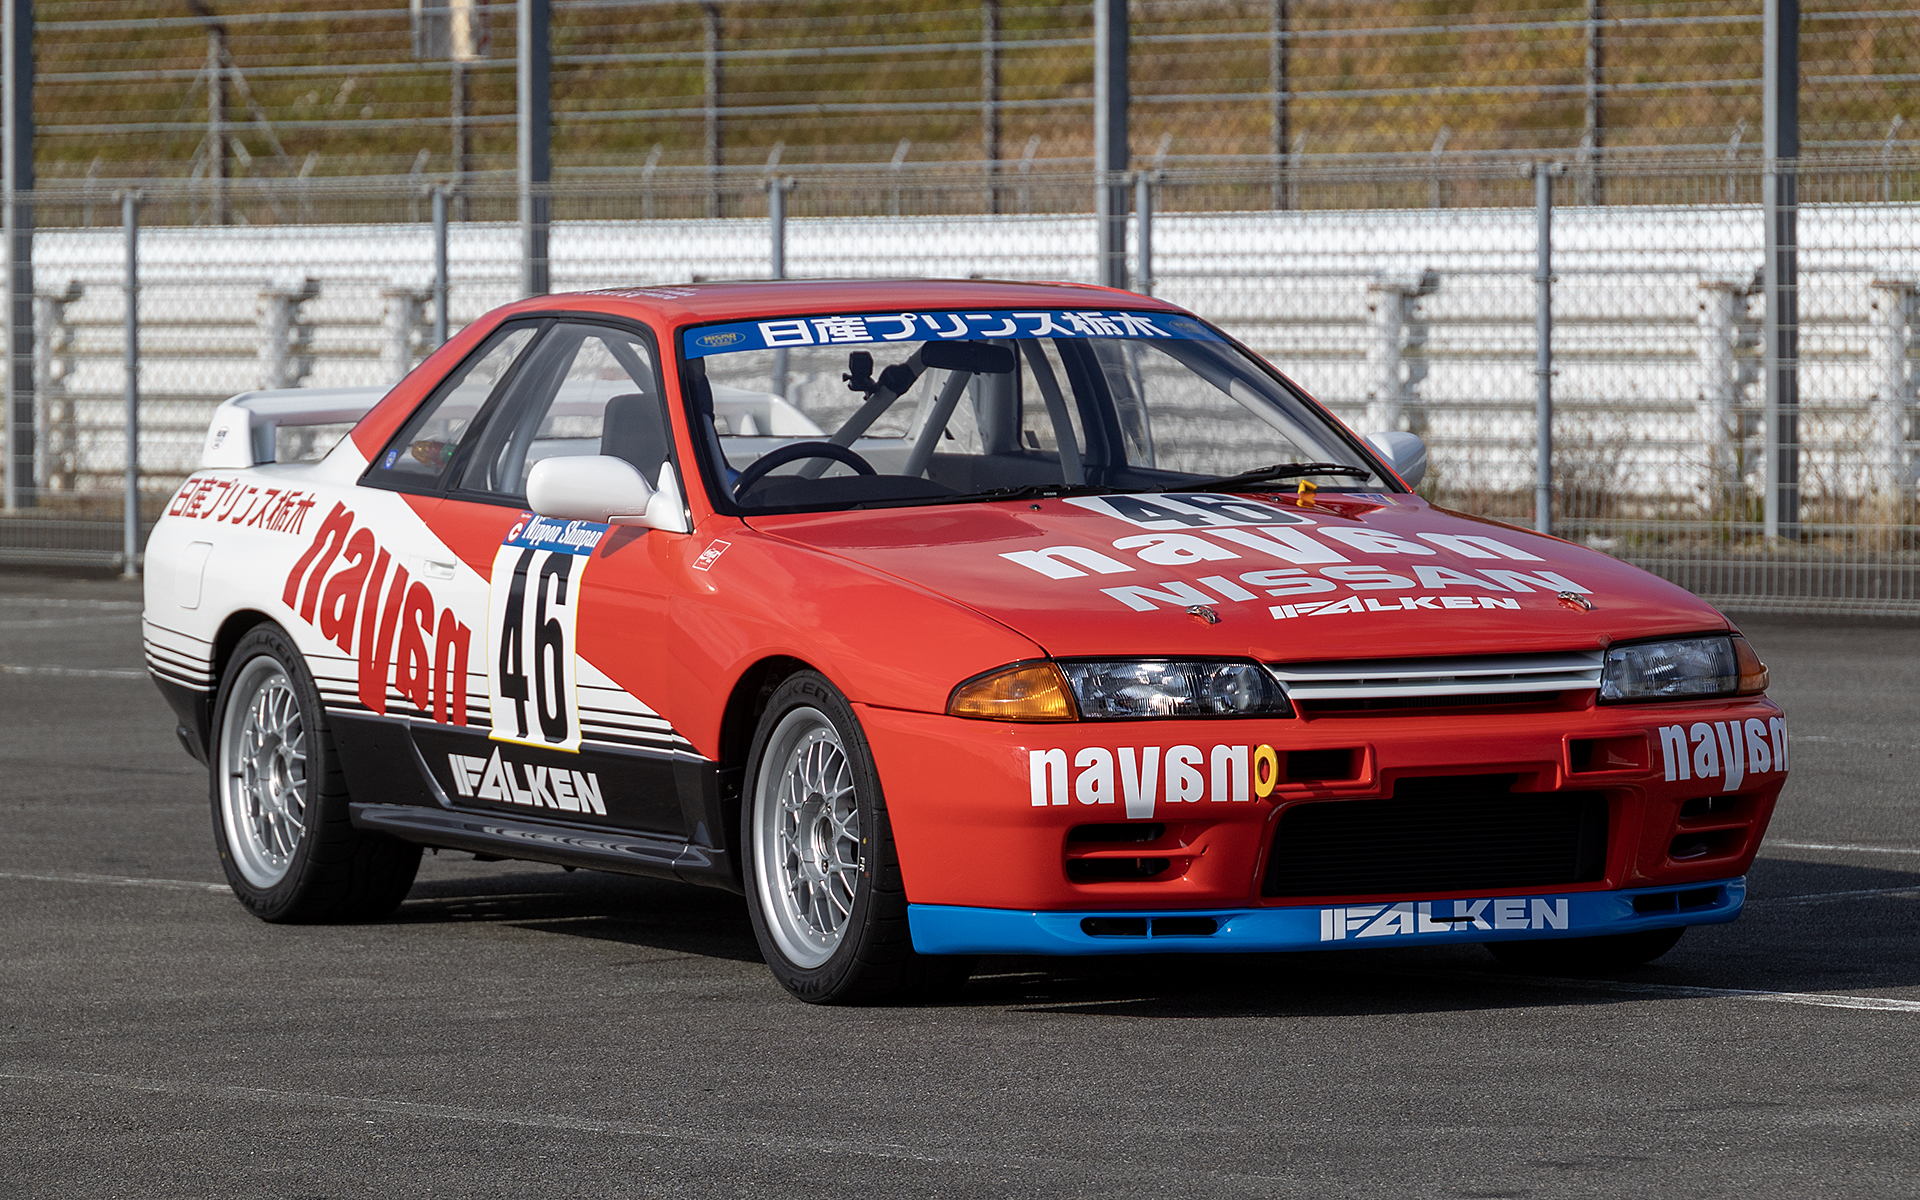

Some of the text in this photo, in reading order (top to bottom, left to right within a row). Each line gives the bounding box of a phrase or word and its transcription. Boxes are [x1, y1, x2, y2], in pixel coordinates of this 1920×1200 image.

[757, 312, 1171, 347] 日産プリンス栃木
[168, 476, 317, 535] 日産プリンス栃木
[1096, 493, 1304, 527] 46
[521, 515, 563, 546] Nippon
[1100, 565, 1594, 612] NISSAN
[1269, 595, 1521, 620] FALKEN
[499, 548, 573, 743] 46
[448, 745, 608, 816] FALKEN
[1320, 898, 1569, 942] FALKEN
